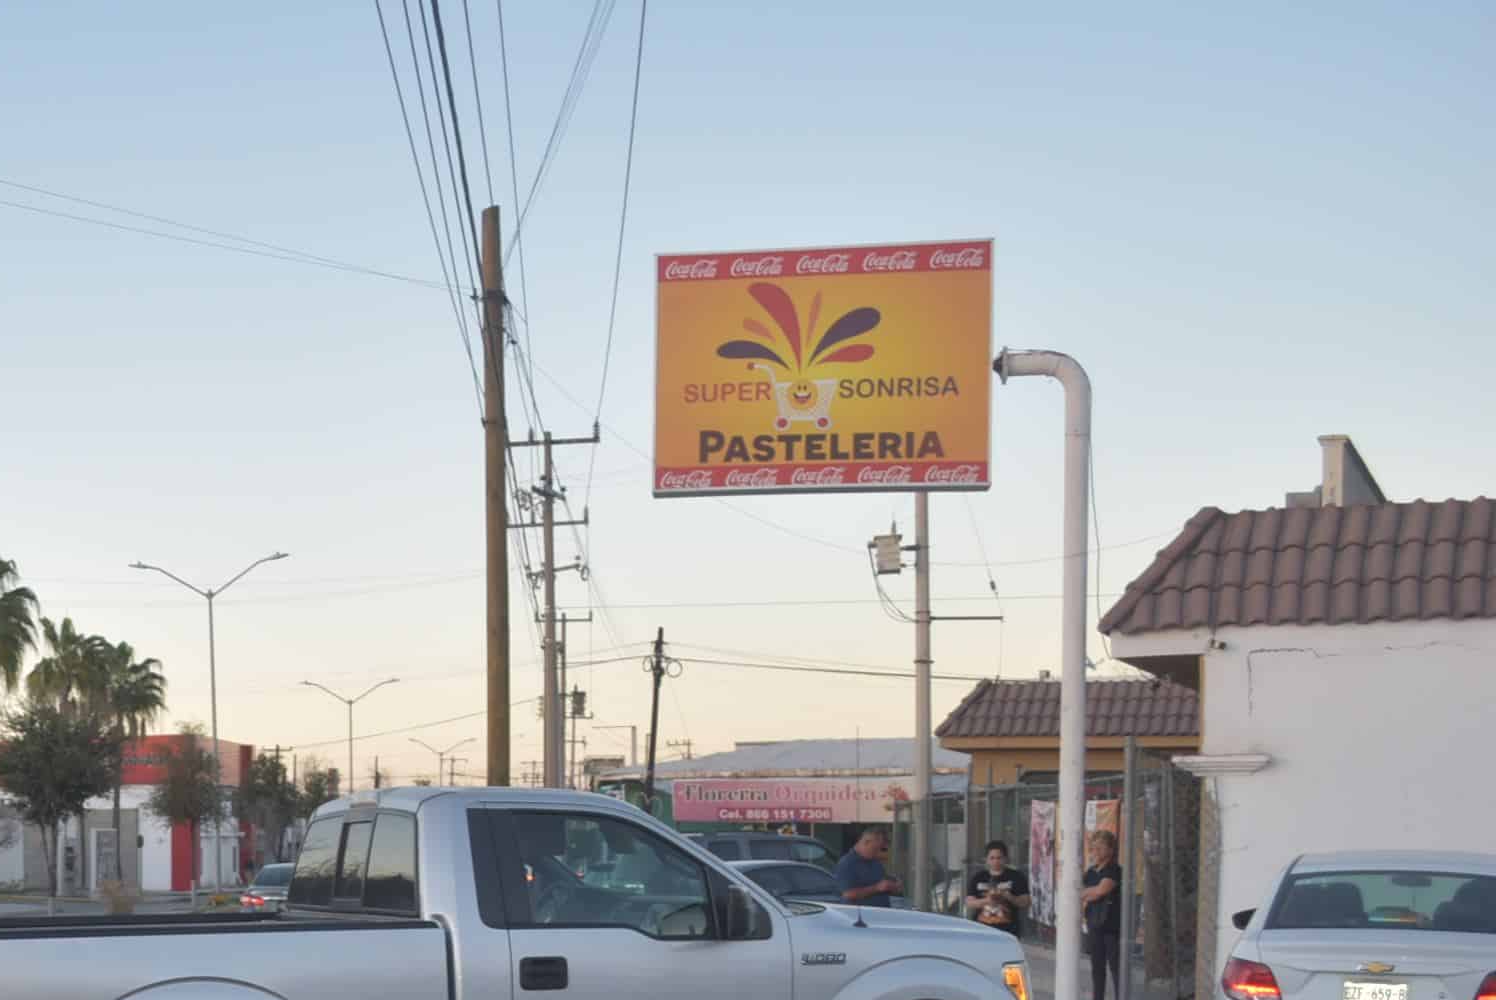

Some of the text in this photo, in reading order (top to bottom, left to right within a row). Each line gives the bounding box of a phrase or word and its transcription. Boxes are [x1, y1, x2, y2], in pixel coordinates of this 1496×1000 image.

[683, 375, 960, 404] SUPER SONRISA
[699, 430, 945, 464] PASTELERIA
